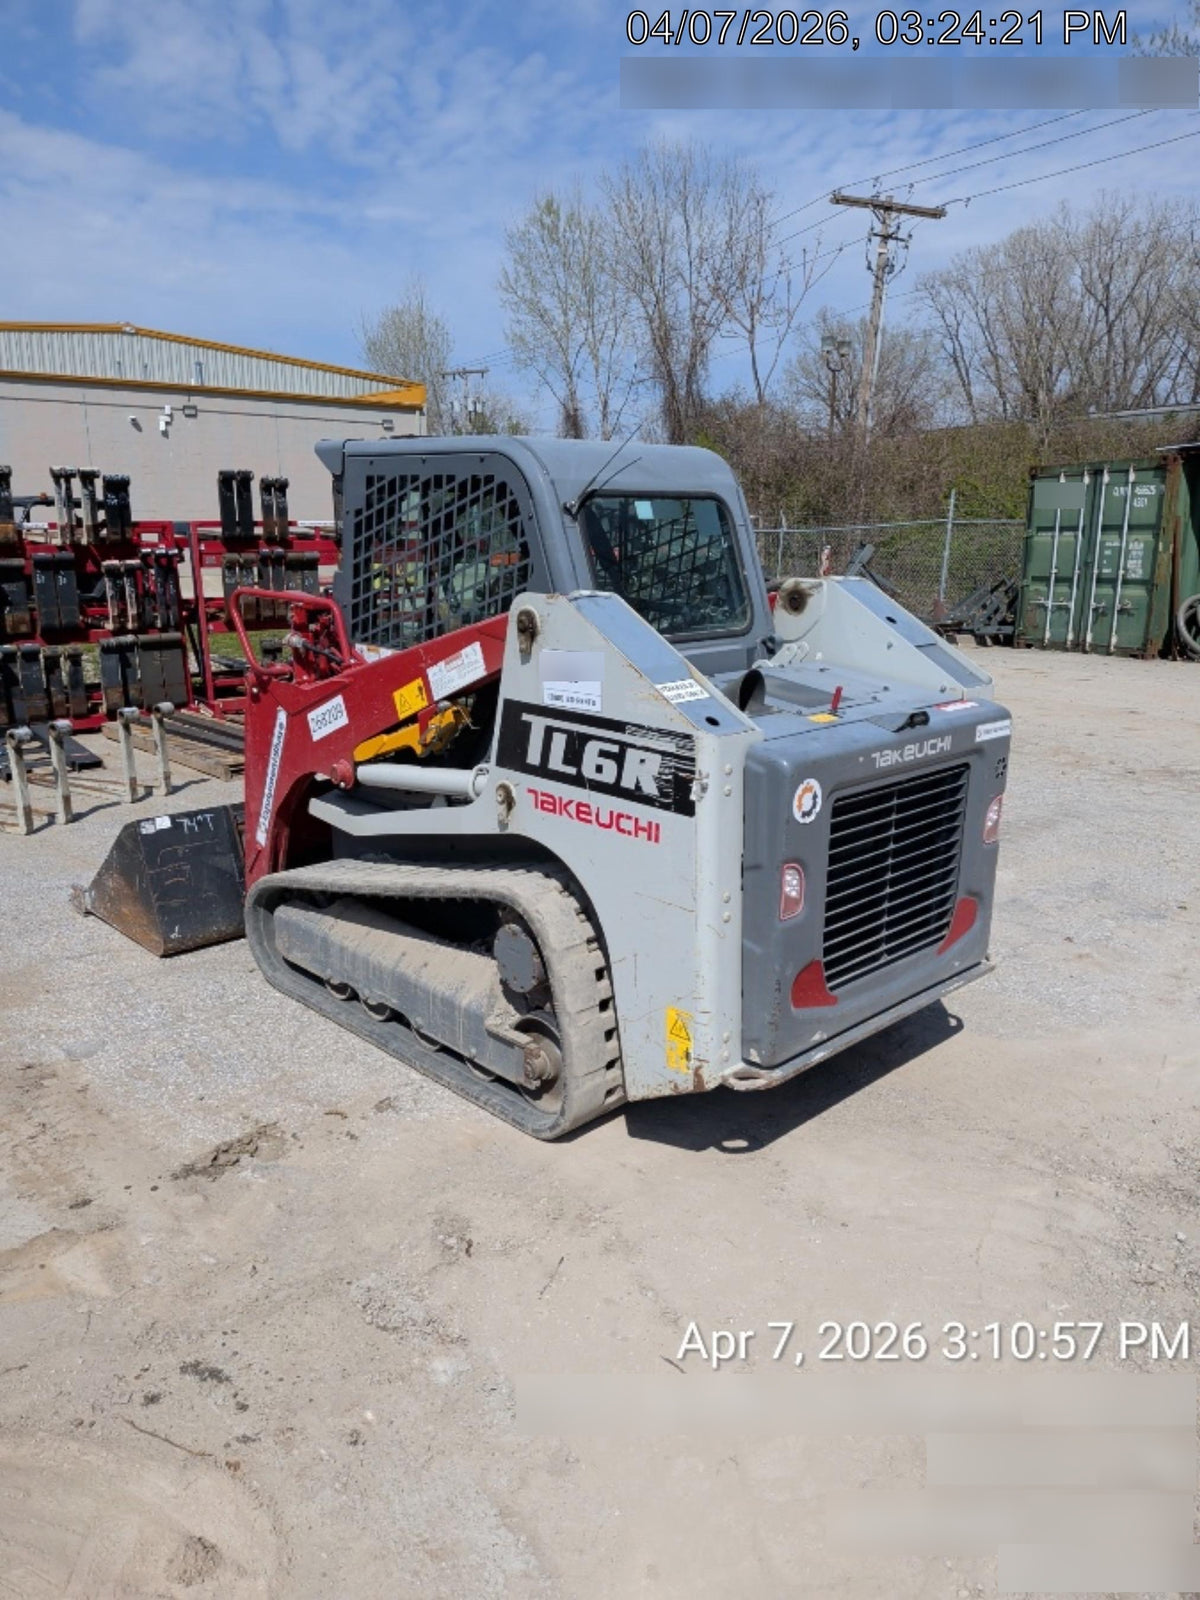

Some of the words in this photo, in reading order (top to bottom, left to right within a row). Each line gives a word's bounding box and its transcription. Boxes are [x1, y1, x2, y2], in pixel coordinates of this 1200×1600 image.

[521, 711, 677, 797] TL6R
[871, 735, 953, 769] TAKEUCHI
[526, 788, 661, 843] TAKEUCHI
